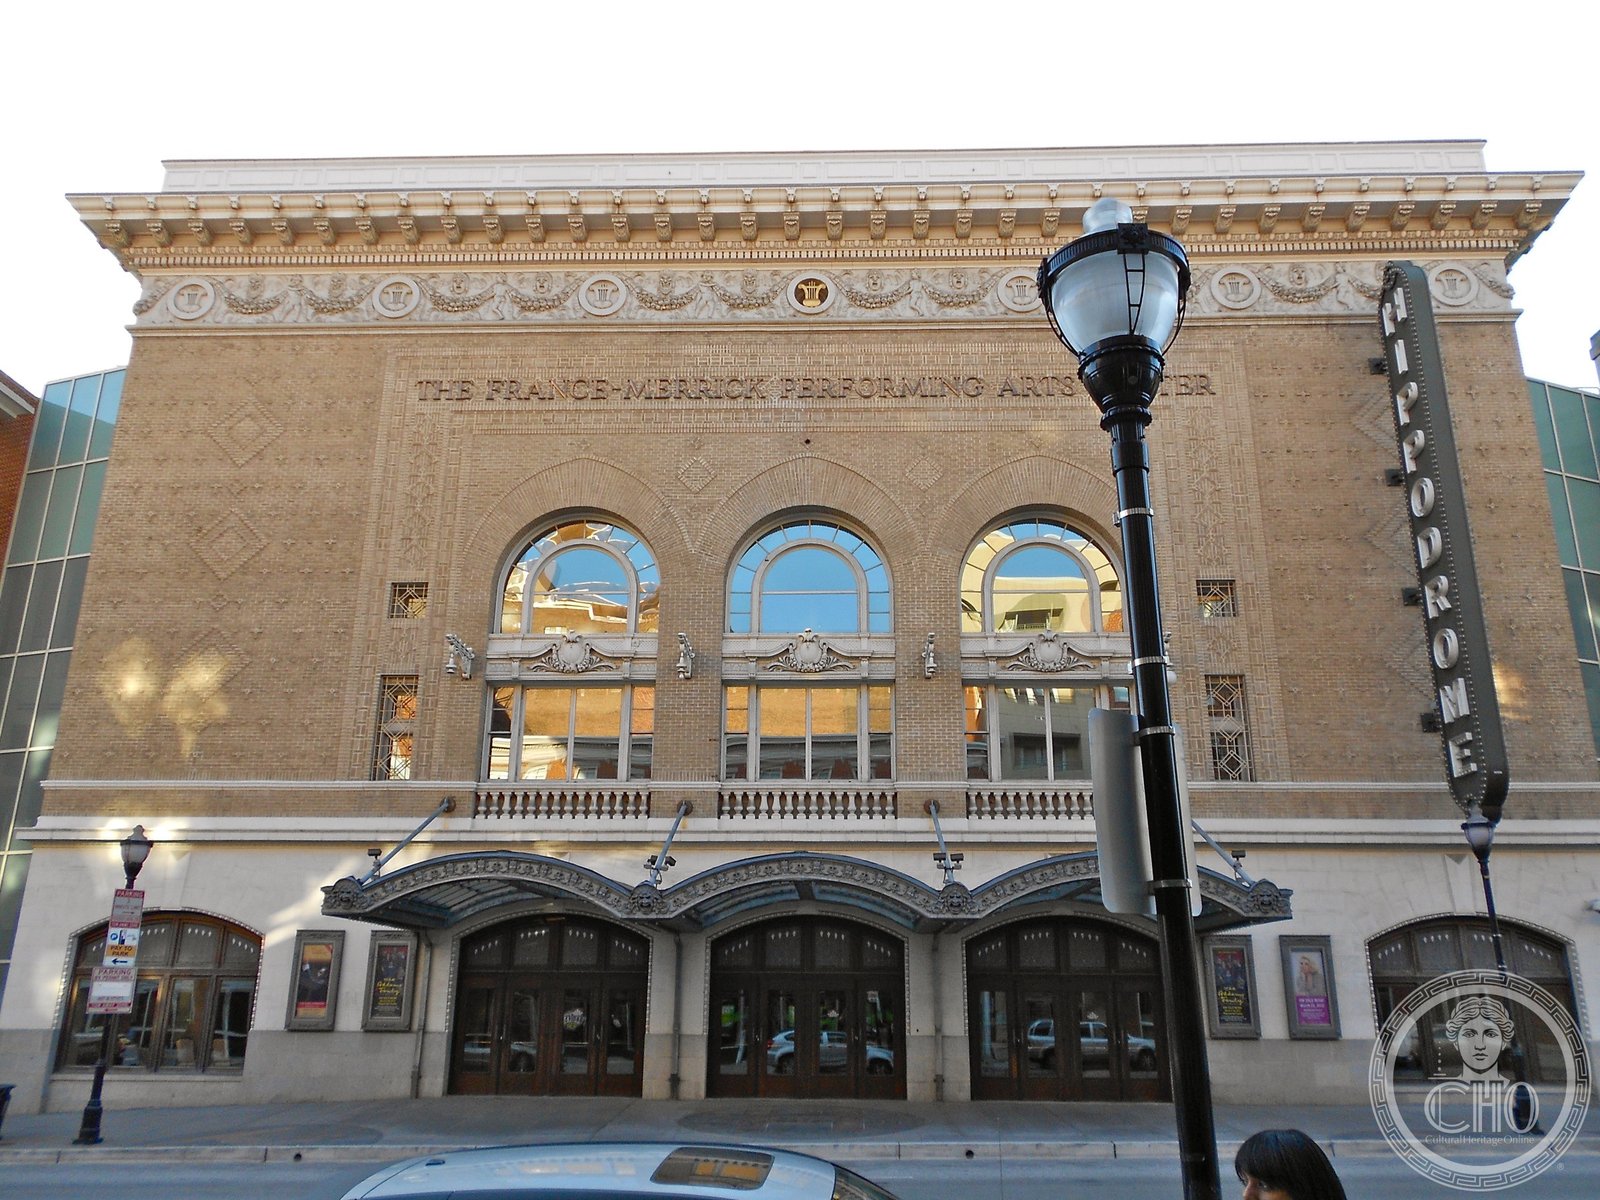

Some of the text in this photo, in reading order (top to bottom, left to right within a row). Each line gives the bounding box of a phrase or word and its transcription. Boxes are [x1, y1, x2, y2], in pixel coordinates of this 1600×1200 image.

[414, 379, 474, 401] THE
[485, 378, 767, 400] FRANCE-MERRICK
[780, 376, 985, 400] PERFORMING
[998, 375, 1077, 397] ARTS
[1382, 287, 1477, 778] HIPPODROME
[116, 890, 143, 898] PARKING
[98, 968, 132, 976] PARKING
